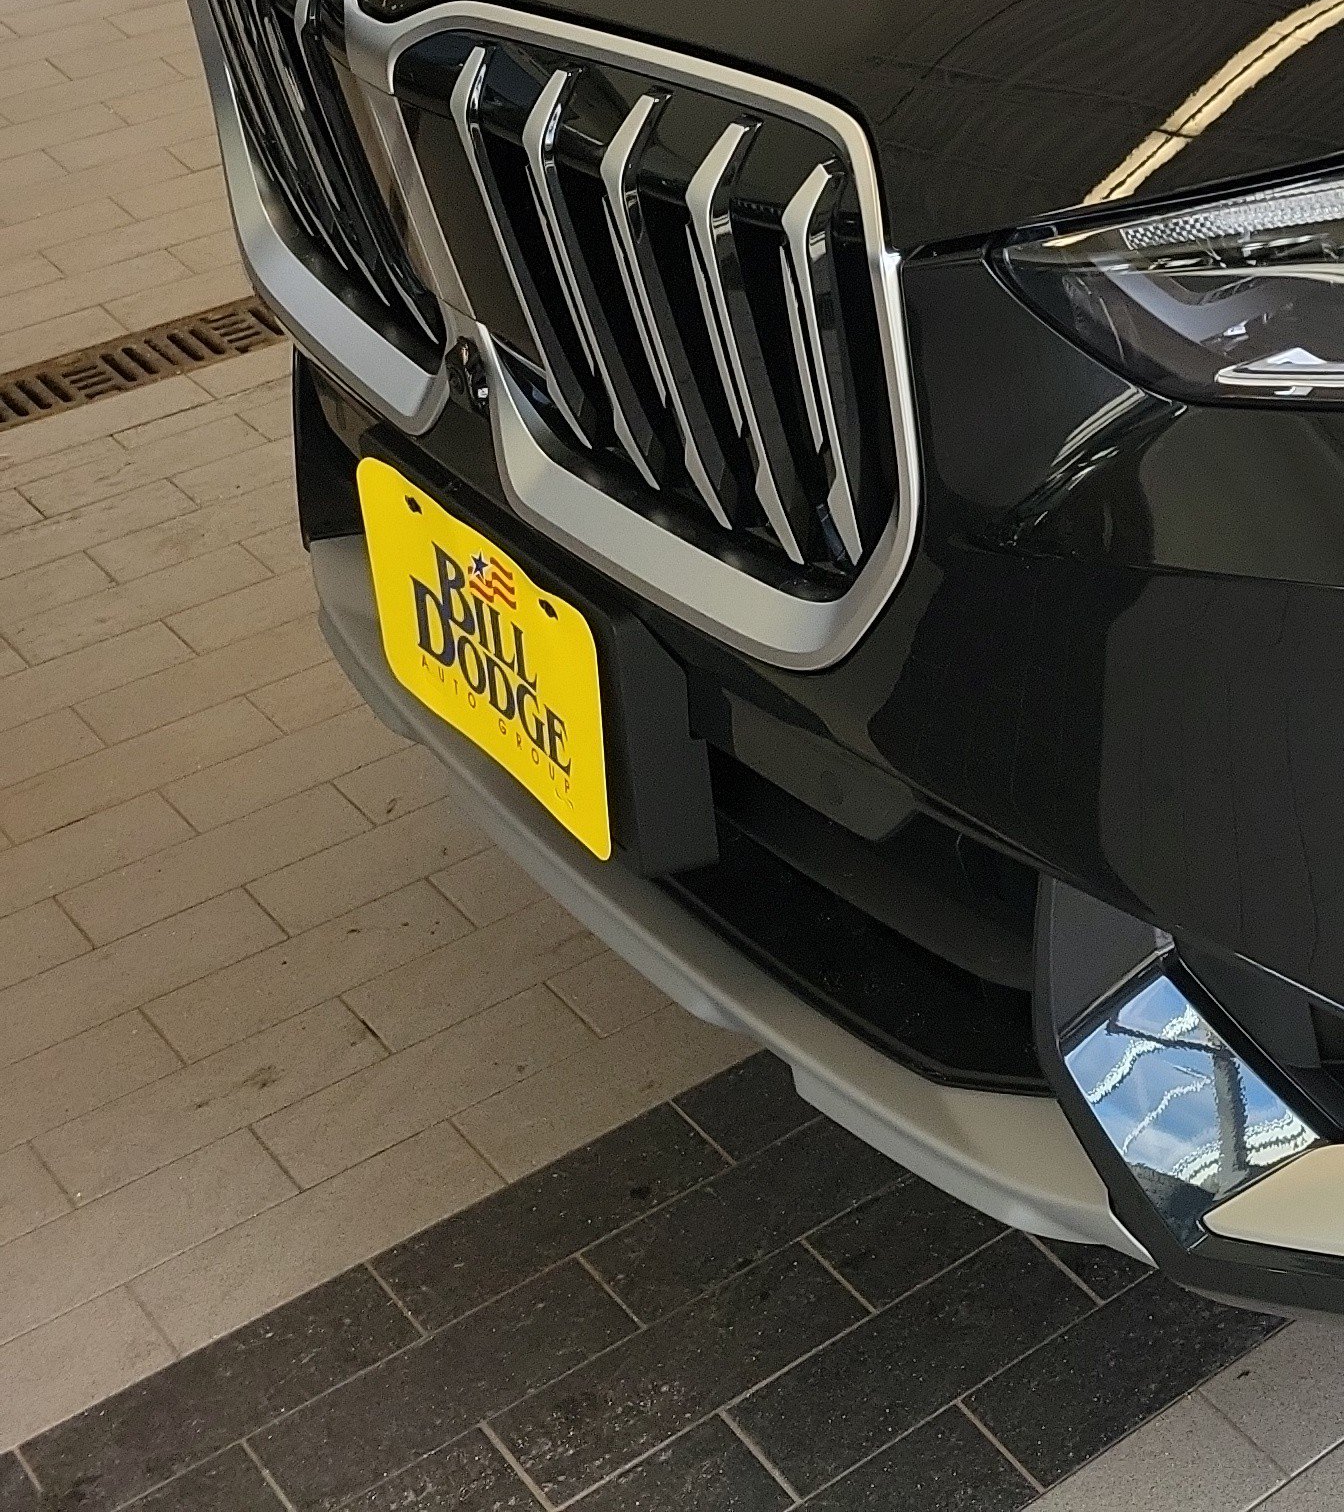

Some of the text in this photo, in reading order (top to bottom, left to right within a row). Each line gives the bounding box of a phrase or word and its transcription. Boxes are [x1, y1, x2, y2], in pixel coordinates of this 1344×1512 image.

[409, 575, 572, 776] DODGE
[431, 541, 538, 684] BILL
[421, 657, 571, 795] AUTO GROUP
